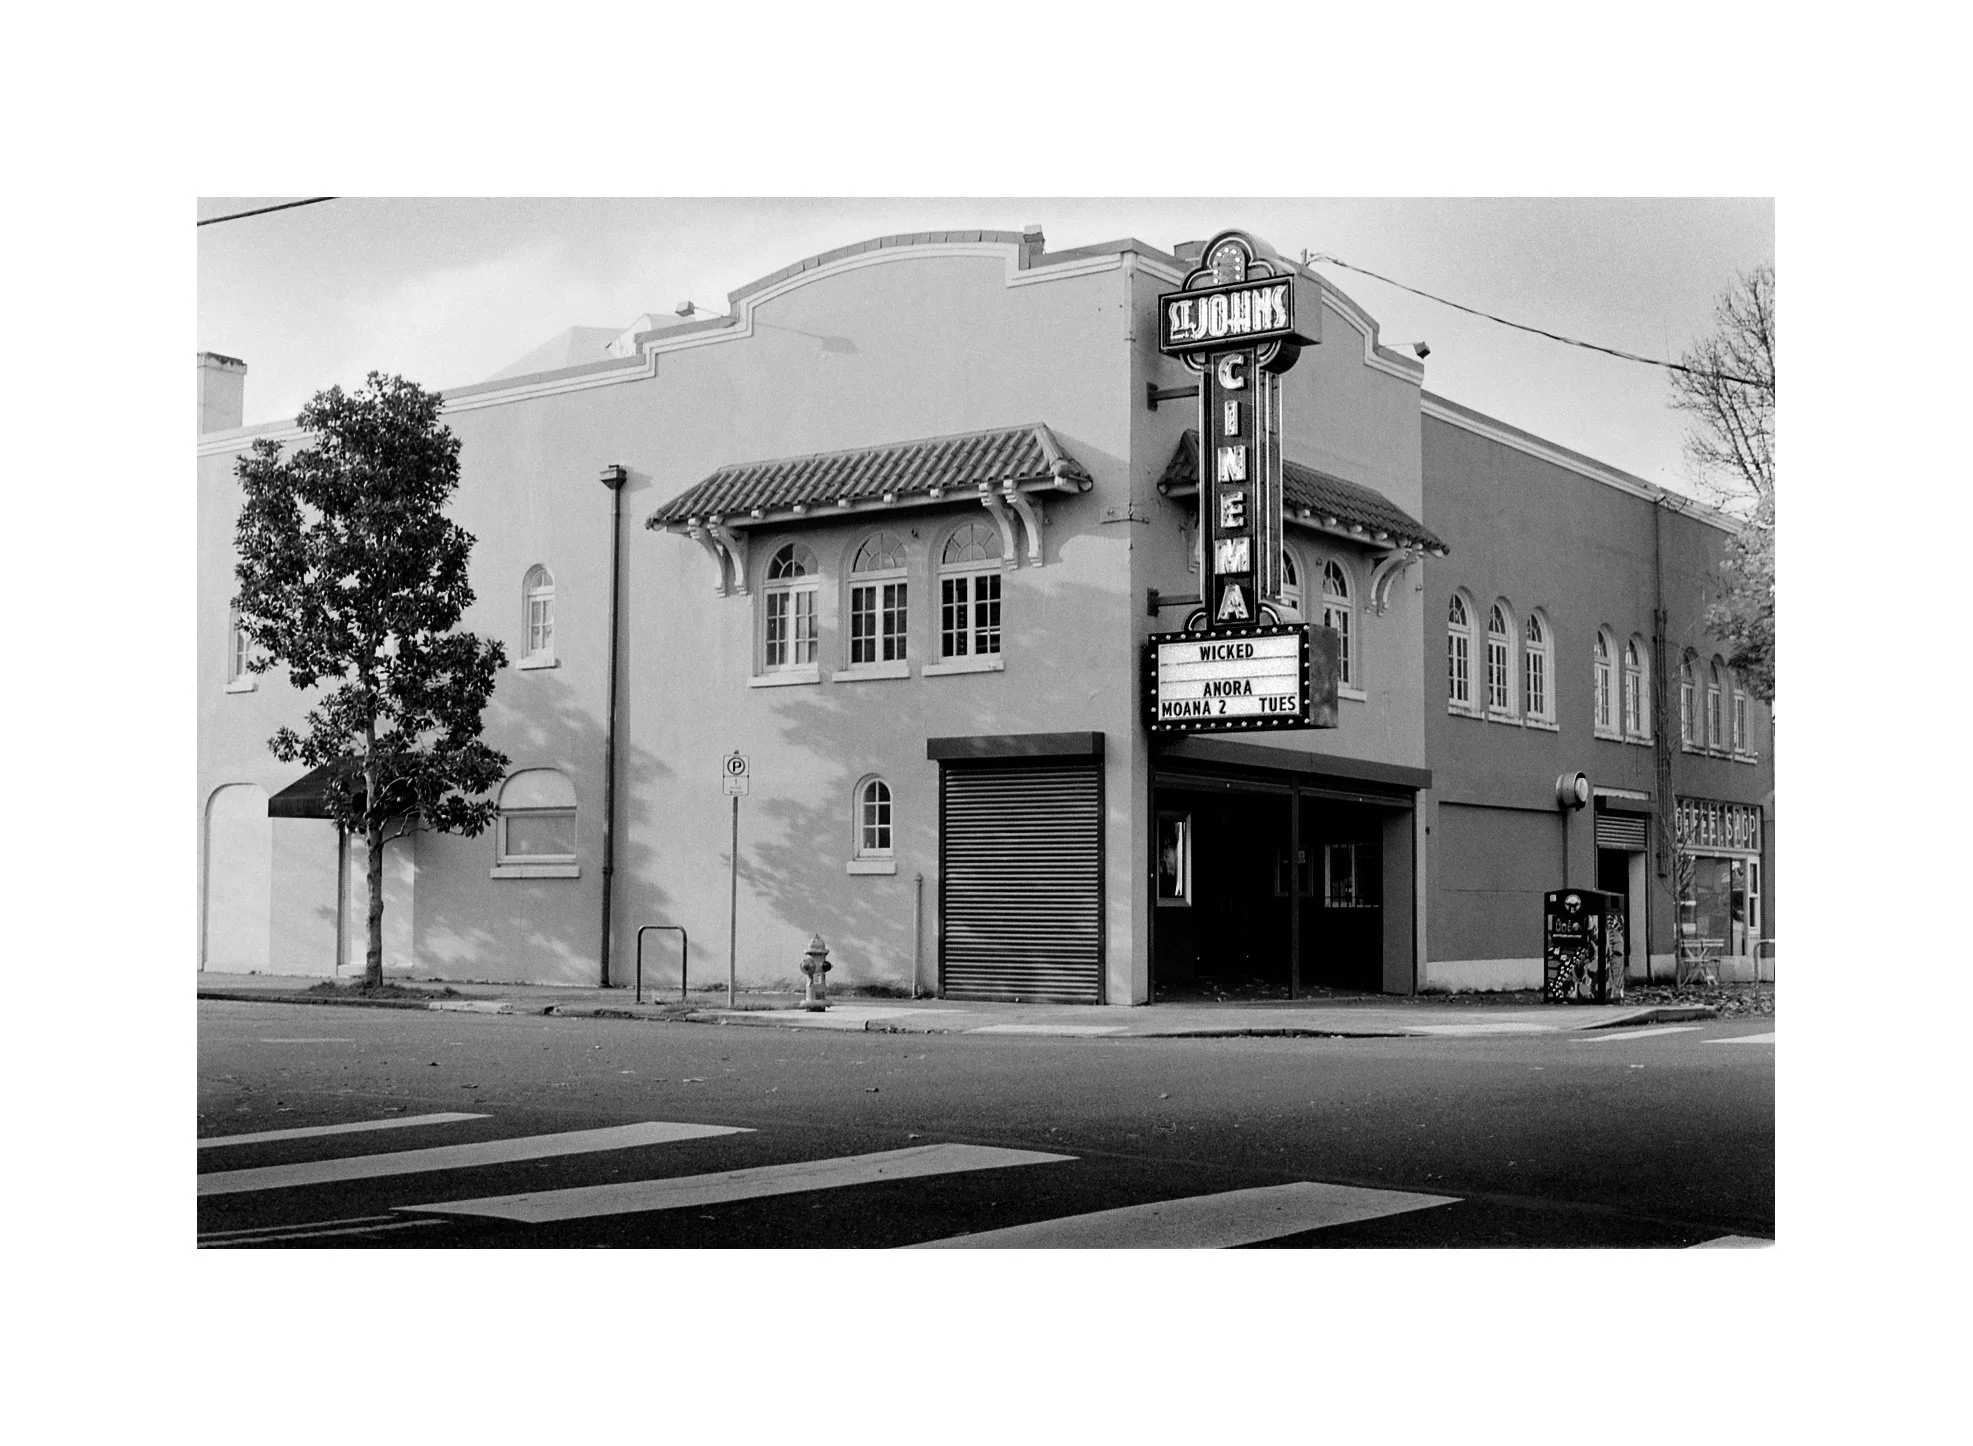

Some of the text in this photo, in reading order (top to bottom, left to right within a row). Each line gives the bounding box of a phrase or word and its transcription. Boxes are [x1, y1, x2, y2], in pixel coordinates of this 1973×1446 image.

[1192, 286, 1288, 340] JOHNS
[1214, 354, 1250, 621] CINEMA
[1200, 643, 1254, 661] WICKED
[1203, 680, 1253, 697] ANORA
[1162, 696, 1296, 717] MOANA 2 TUES
[732, 760, 742, 772] P
[1674, 807, 1757, 841] OFFEE SHOP
